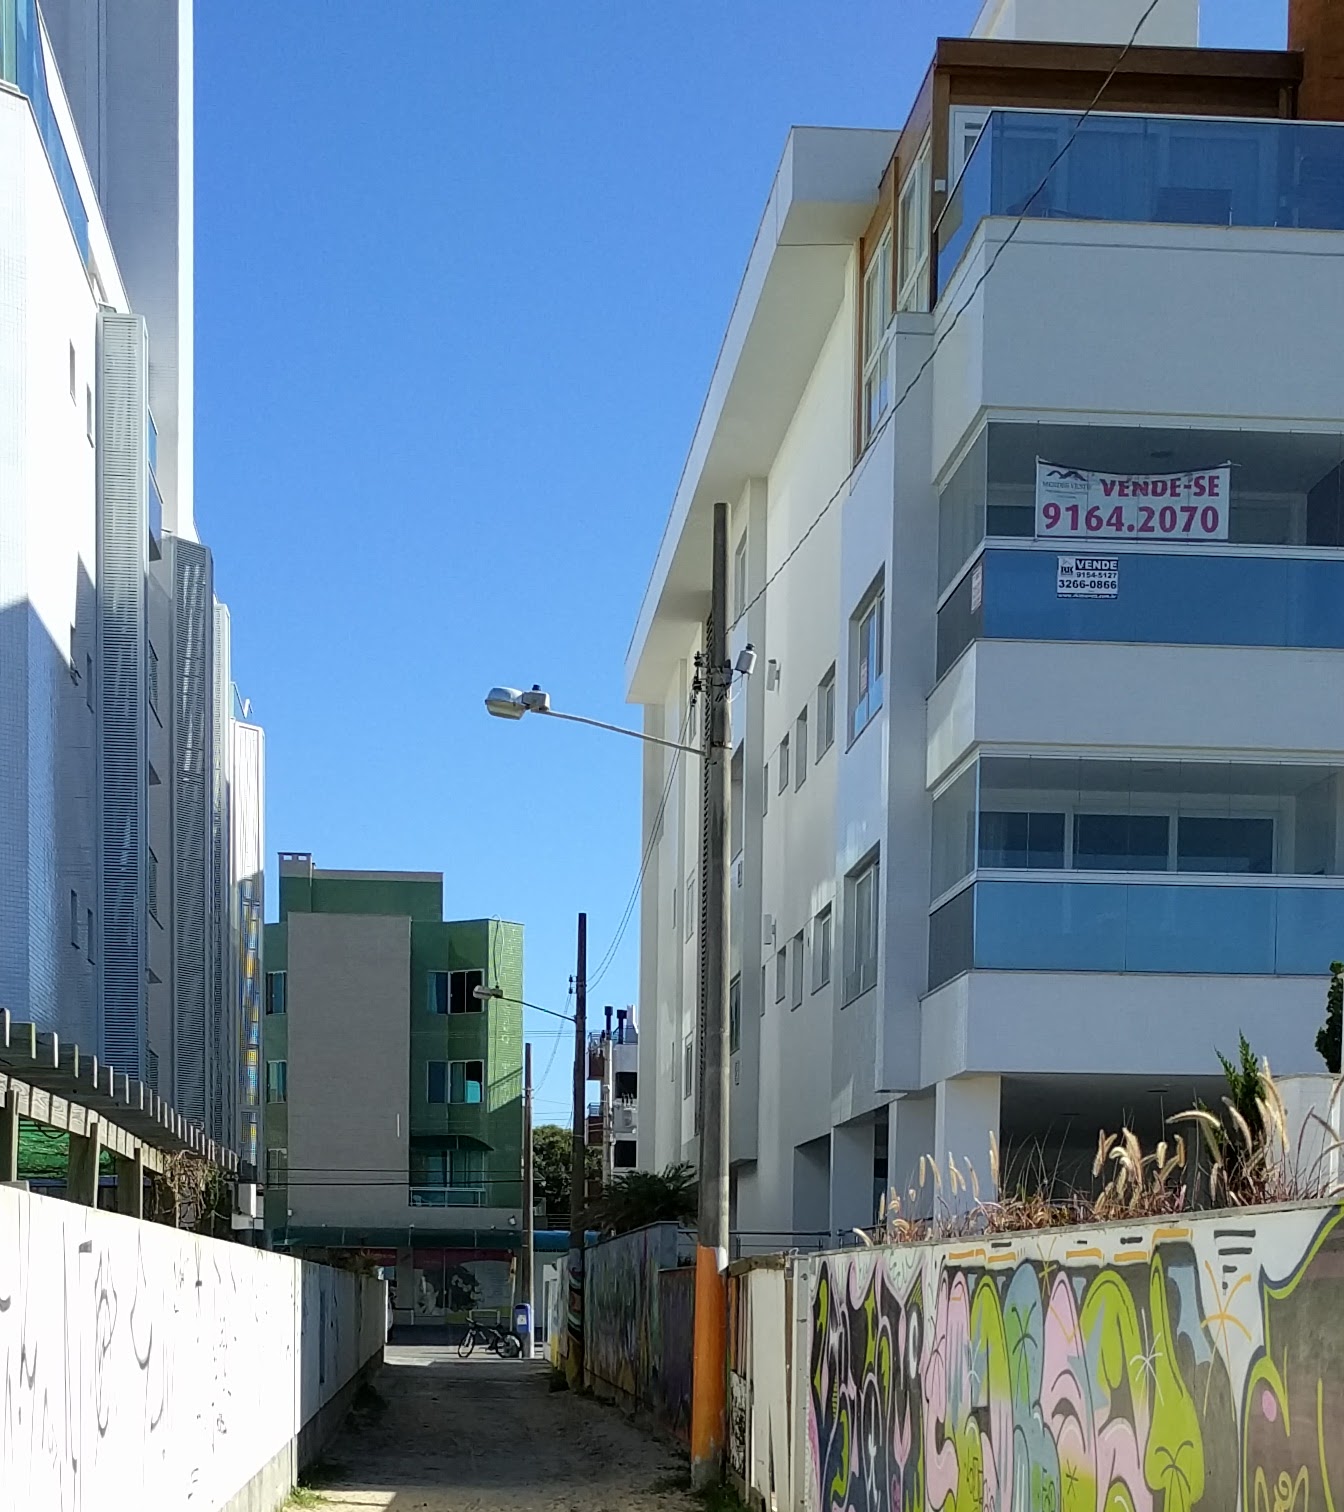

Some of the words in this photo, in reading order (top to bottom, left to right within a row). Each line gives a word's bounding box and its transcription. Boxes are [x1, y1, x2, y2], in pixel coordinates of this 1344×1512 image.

[1099, 475, 1220, 498] VENDE-SE
[1042, 502, 1219, 533] 9164.2070
[1076, 559, 1118, 570] VENDE
[1058, 579, 1117, 589] 3266-0866
